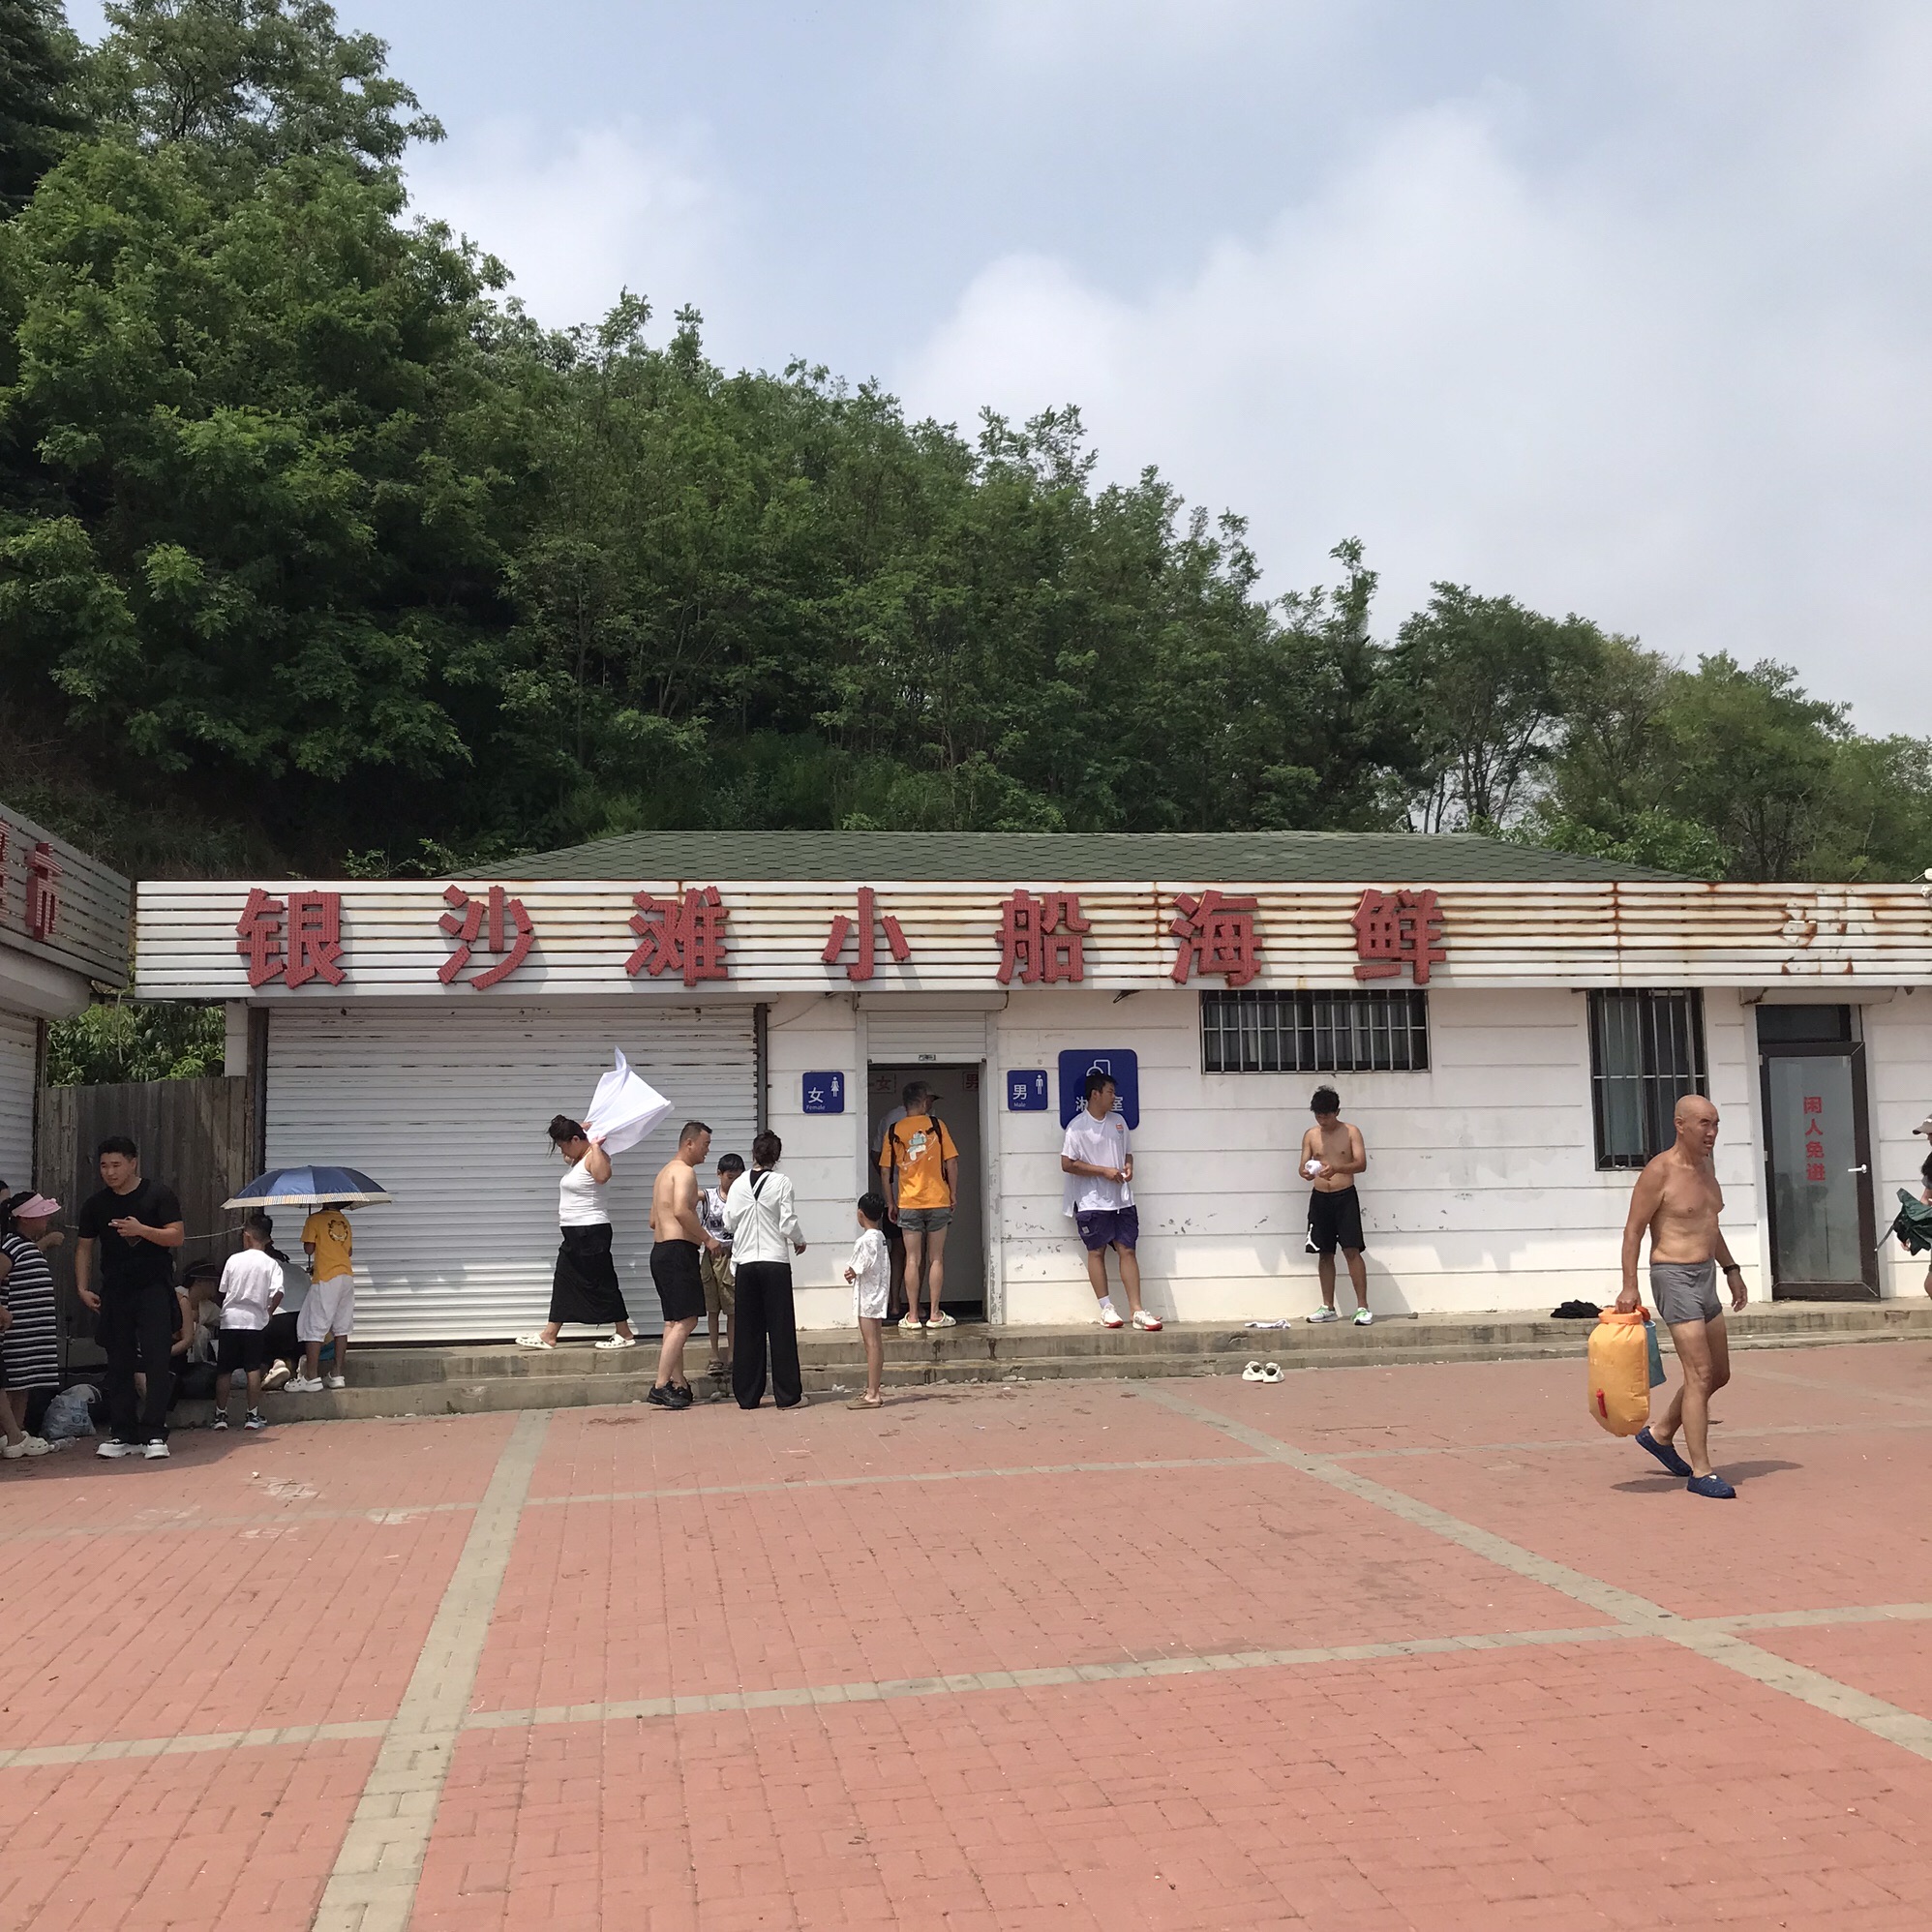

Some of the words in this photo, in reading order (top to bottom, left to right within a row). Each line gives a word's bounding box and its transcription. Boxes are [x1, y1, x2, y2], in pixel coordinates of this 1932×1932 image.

[236, 885, 1447, 989] 银沙滩小船海鲜
[875, 1075, 891, 1091] 女
[965, 1073, 980, 1090] 男
[807, 1086, 824, 1103] 女
[1012, 1084, 1027, 1101] 男
[1074, 1096, 1124, 1112] 淋室
